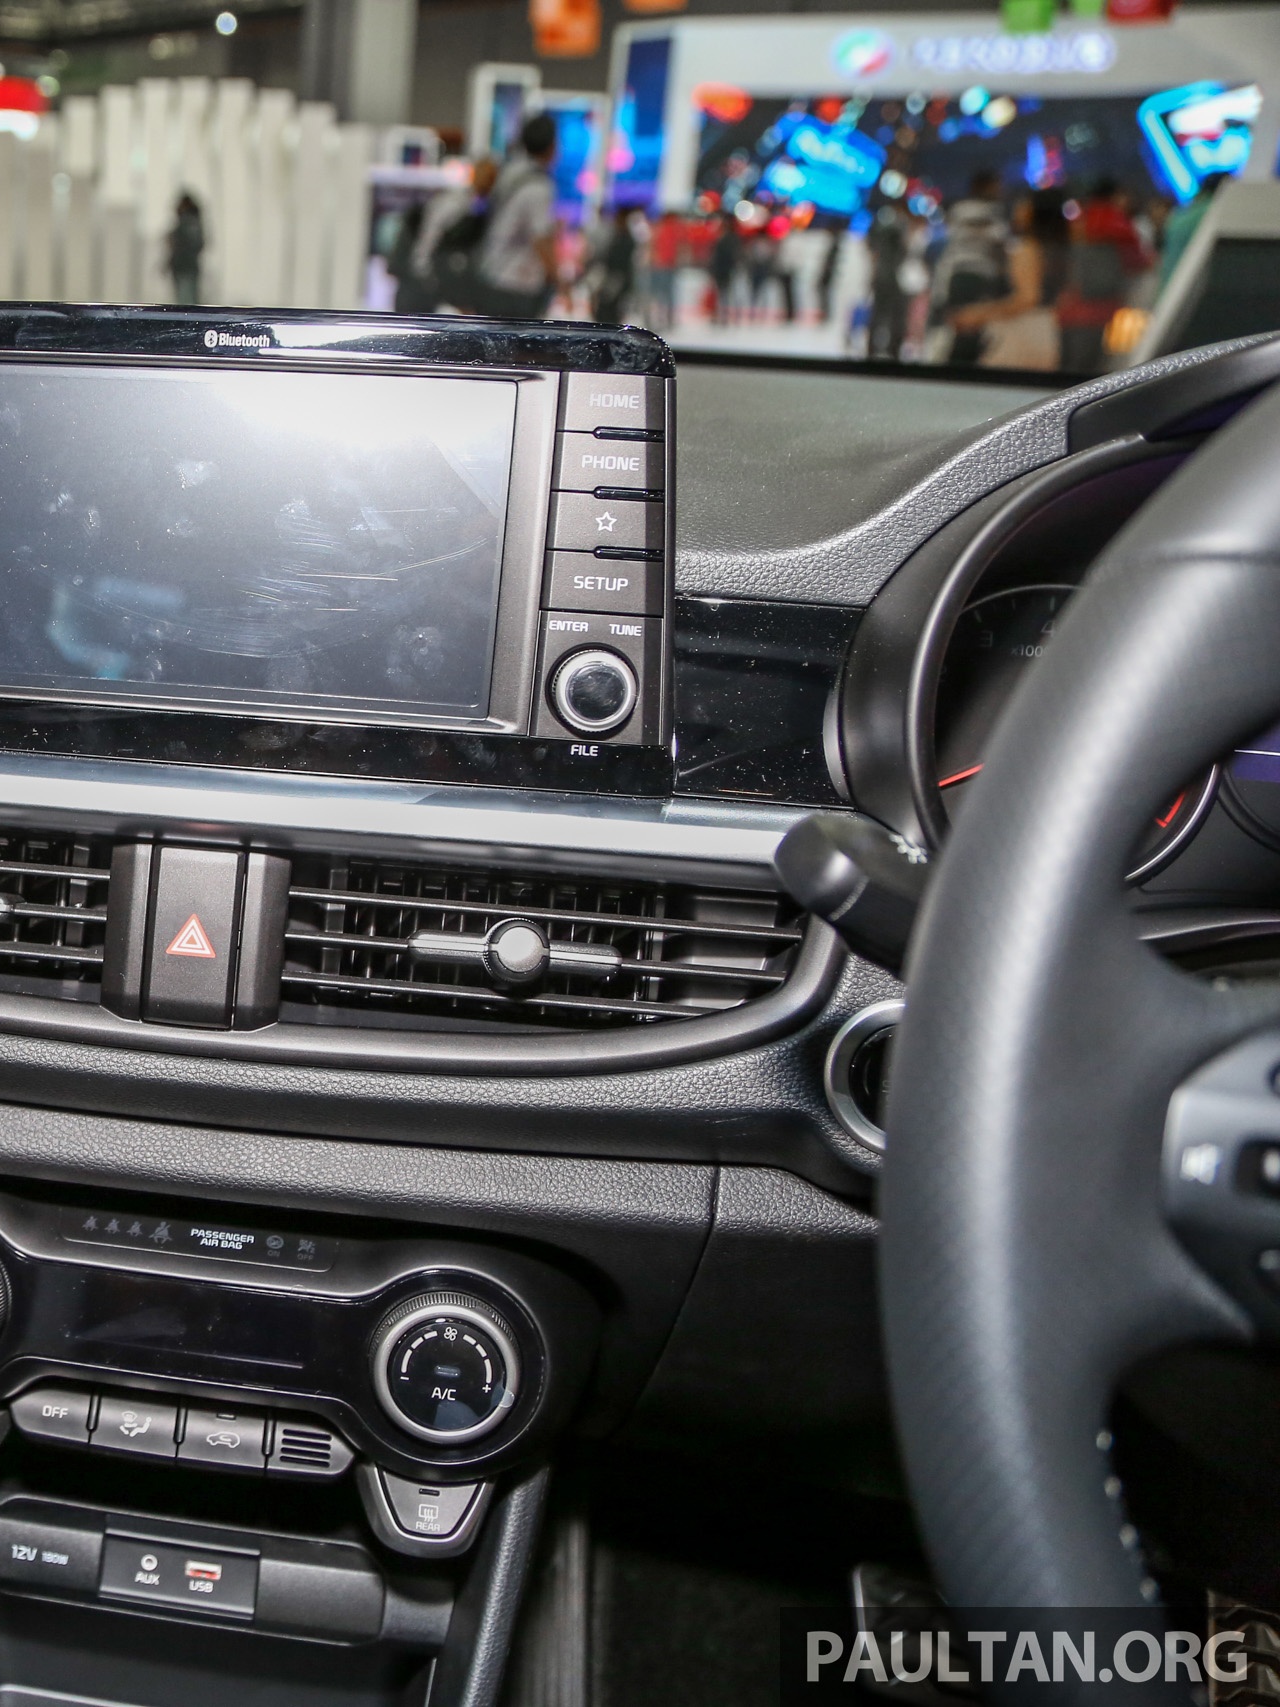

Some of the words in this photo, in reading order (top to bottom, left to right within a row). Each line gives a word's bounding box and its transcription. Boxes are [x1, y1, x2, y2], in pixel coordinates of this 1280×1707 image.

[218, 333, 270, 347] Bluetooth
[589, 393, 640, 409] HOME
[581, 455, 640, 471] PHONE
[573, 575, 629, 592] SETUP
[548, 620, 589, 632] ENTER
[609, 623, 642, 637] TUNE
[570, 744, 599, 757] FILE
[190, 1228, 255, 1244] PASSENGER
[200, 1238, 219, 1247] AIR
[220, 1240, 243, 1250] BAG
[431, 1387, 457, 1401] A/C
[42, 1405, 69, 1419] OFF
[415, 1521, 441, 1532] REAR
[11, 1544, 38, 1562] 12V
[134, 1571, 161, 1585] AUX
[188, 1580, 214, 1593] USB
